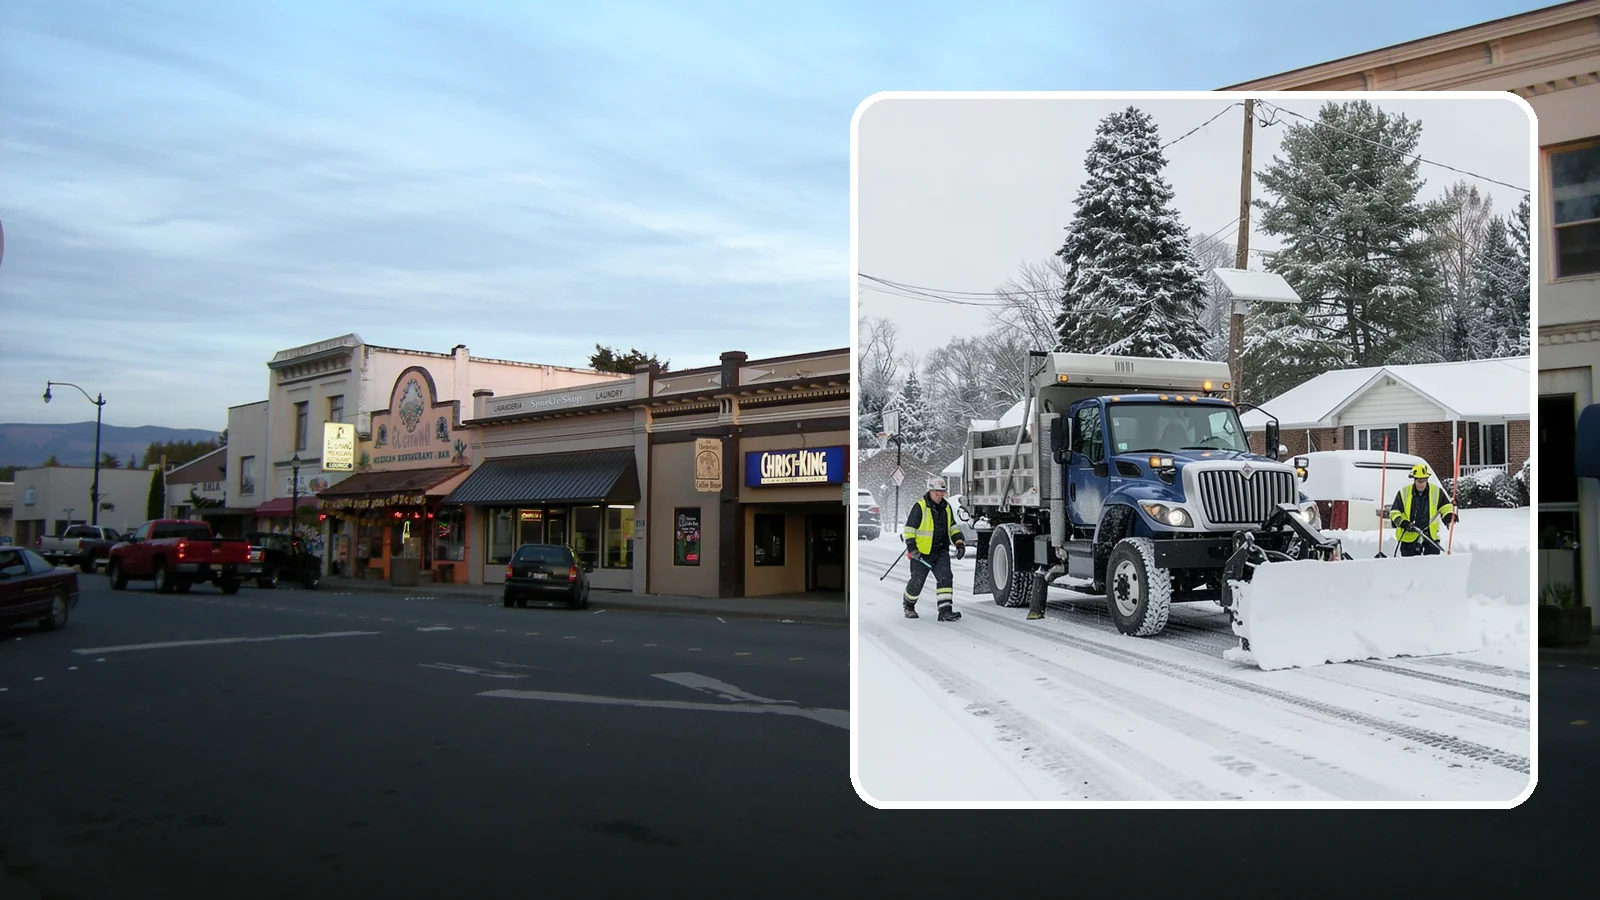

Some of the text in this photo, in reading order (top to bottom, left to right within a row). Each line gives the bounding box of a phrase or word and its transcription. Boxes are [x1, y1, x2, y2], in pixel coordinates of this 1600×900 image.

[493, 389, 624, 412] LAVANDERIA Sparkle Shop LAUNDRY
[373, 454, 396, 464] MEXICAN
[397, 451, 433, 462] RESTAURANT
[438, 450, 450, 459] BAR
[761, 450, 827, 477] CHRIST KING
[710, 481, 722, 489] House
